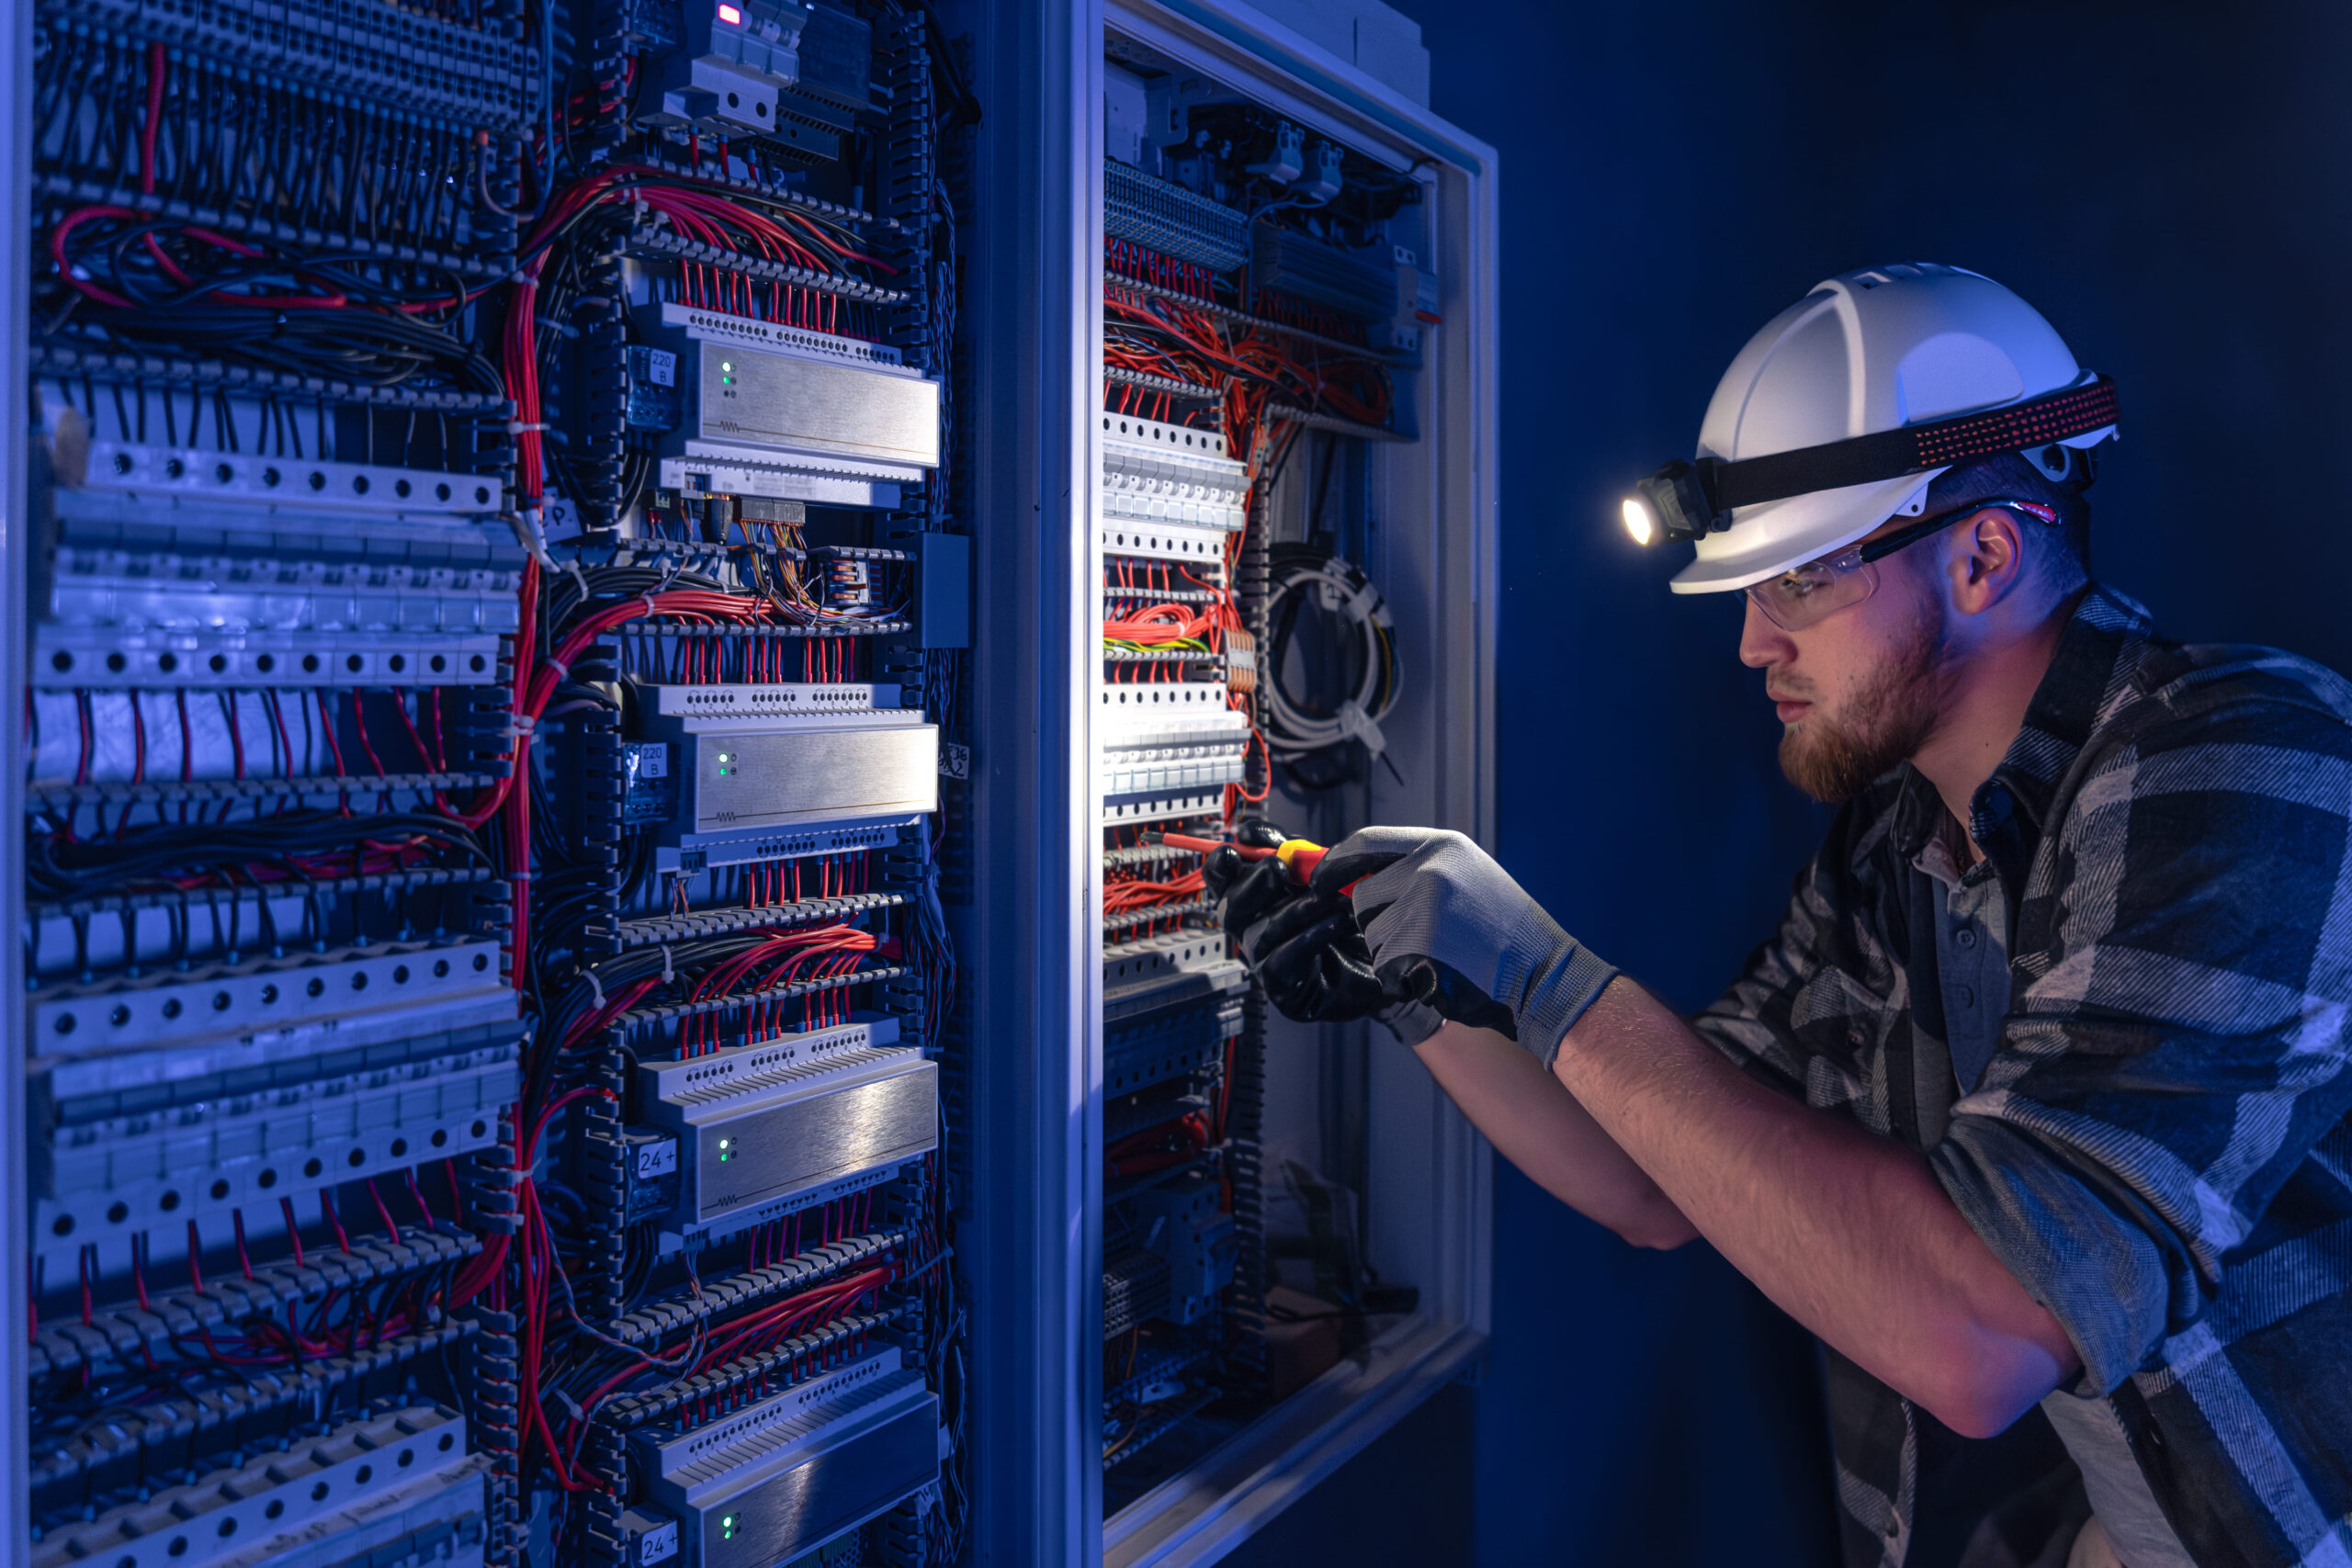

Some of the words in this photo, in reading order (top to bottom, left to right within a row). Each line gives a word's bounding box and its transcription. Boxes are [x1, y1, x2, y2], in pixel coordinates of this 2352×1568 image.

[652, 353, 671, 367] 220
[660, 370, 667, 383] B
[643, 747, 662, 760] 220
[650, 763, 659, 776] B
[640, 1151, 662, 1171] 24
[644, 1535, 664, 1560] 24
